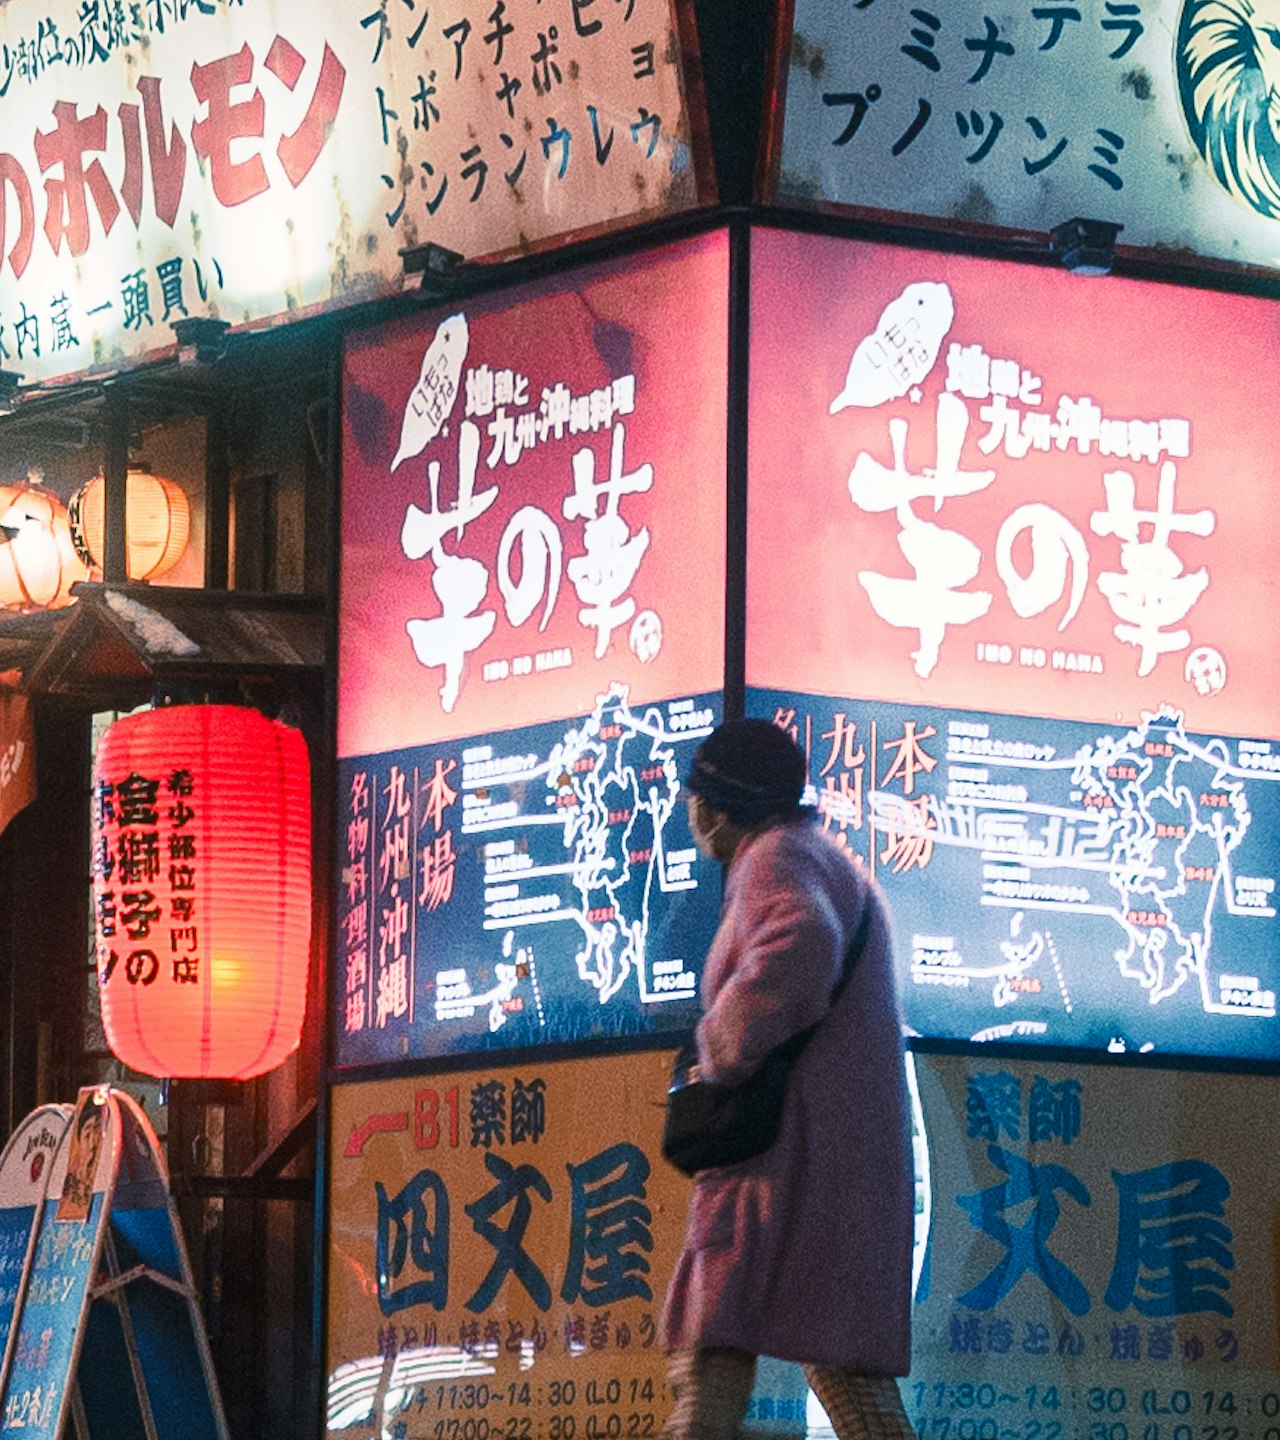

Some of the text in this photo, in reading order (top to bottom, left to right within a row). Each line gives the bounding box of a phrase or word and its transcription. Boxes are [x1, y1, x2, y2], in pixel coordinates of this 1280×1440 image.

[1020, 648, 1047, 669] NO
[1052, 652, 1104, 674] HANA
[118, 772, 160, 986] 金獅子の
[167, 769, 198, 984] 希少部位専門店
[377, 765, 410, 1028] 九州・沖縄
[419, 759, 457, 913] 本場
[415, 1078, 547, 1149] B1 薬師
[375, 1142, 654, 1318] 四文屋
